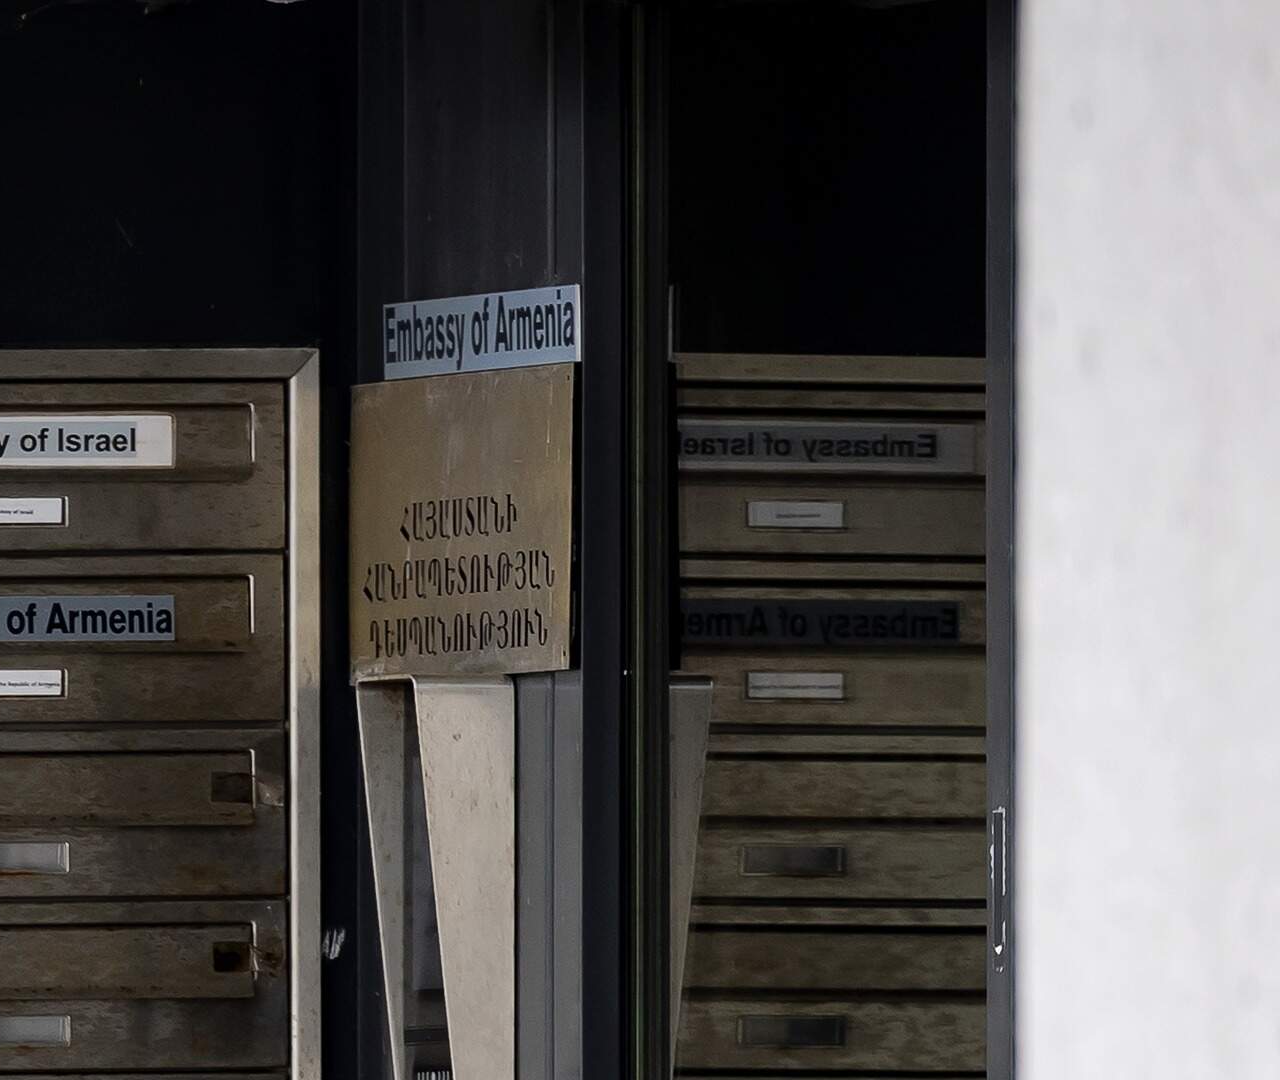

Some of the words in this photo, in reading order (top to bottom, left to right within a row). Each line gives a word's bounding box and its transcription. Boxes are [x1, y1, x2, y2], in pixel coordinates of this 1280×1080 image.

[386, 304, 465, 370] Embassy
[471, 297, 489, 356] of
[495, 289, 575, 353] Armenia
[20, 428, 49, 452] of
[58, 428, 136, 452] Israel
[400, 494, 517, 542] ՀԱՅԱՍՏԱՆԻ
[6, 603, 37, 635] of
[46, 602, 172, 635] Armenia
